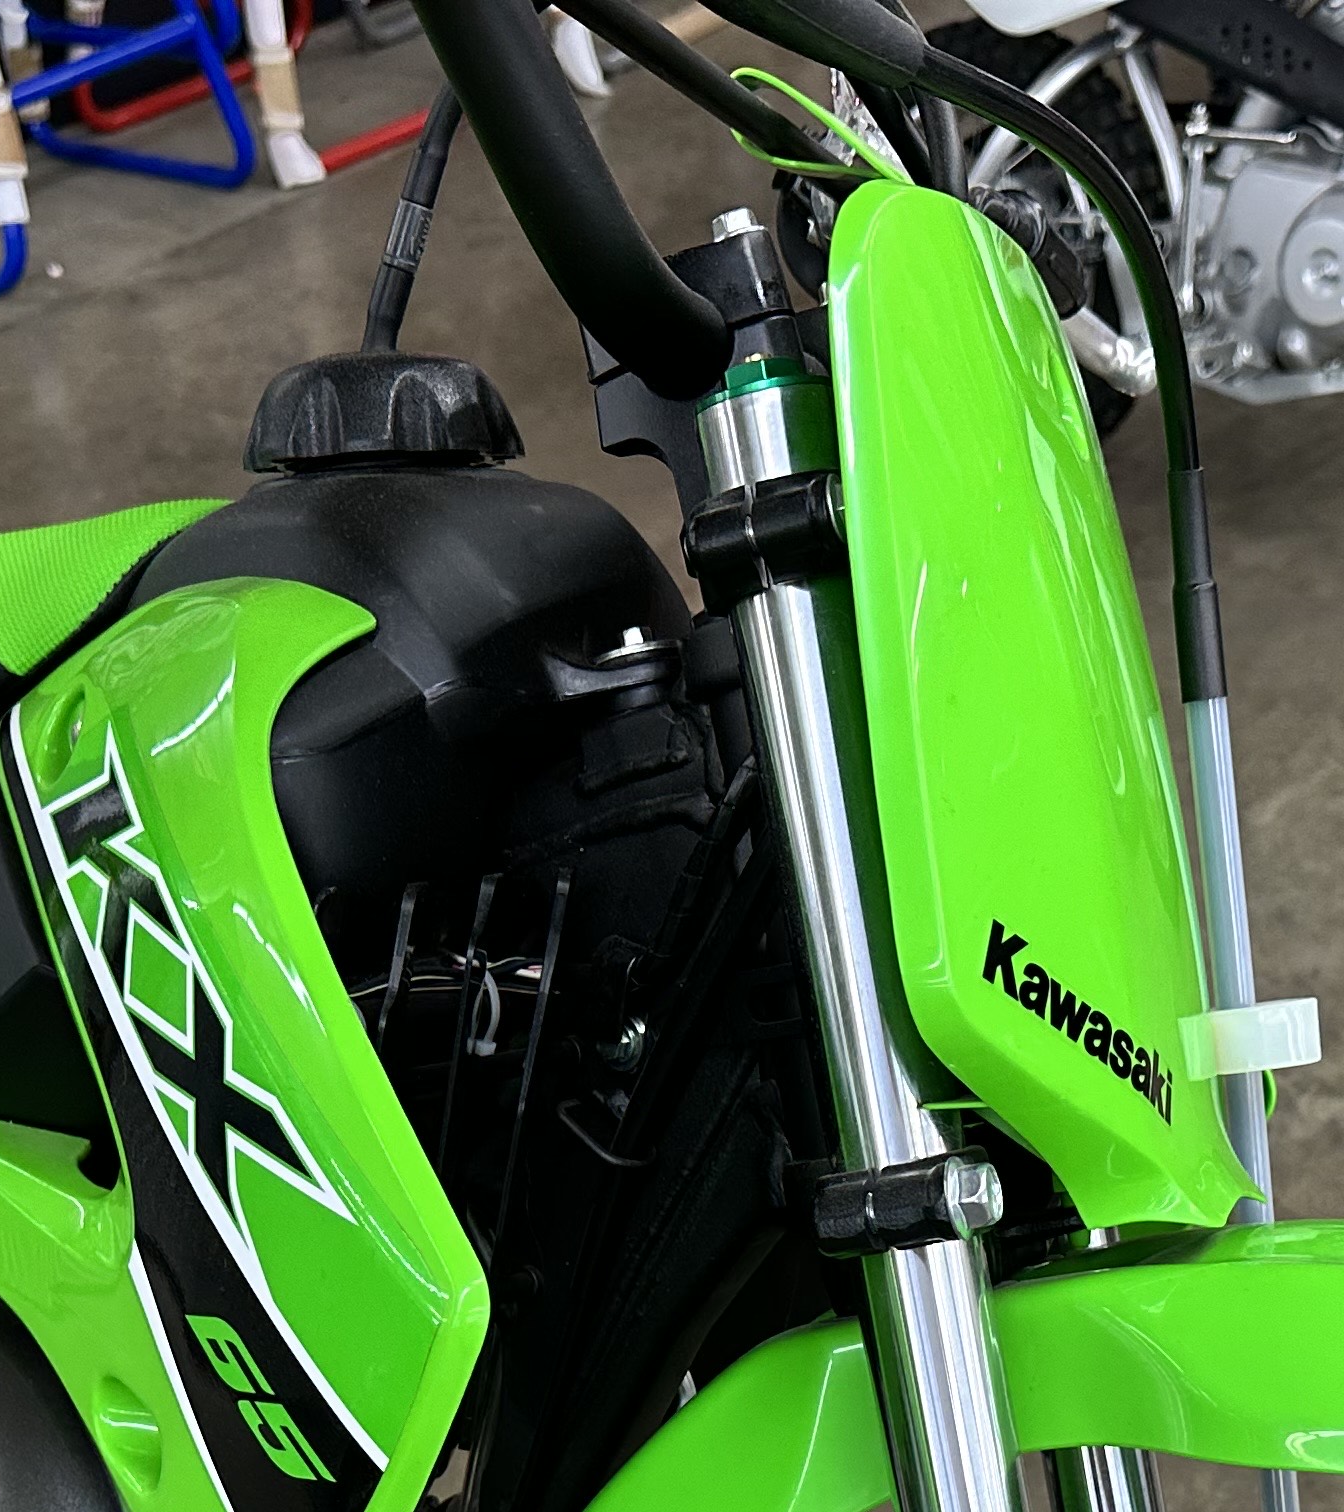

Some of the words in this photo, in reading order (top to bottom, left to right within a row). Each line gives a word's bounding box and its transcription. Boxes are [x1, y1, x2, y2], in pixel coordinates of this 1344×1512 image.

[43, 720, 360, 1251] KX
[981, 918, 1174, 1126] Kawasaki
[187, 1313, 337, 1484] 65
